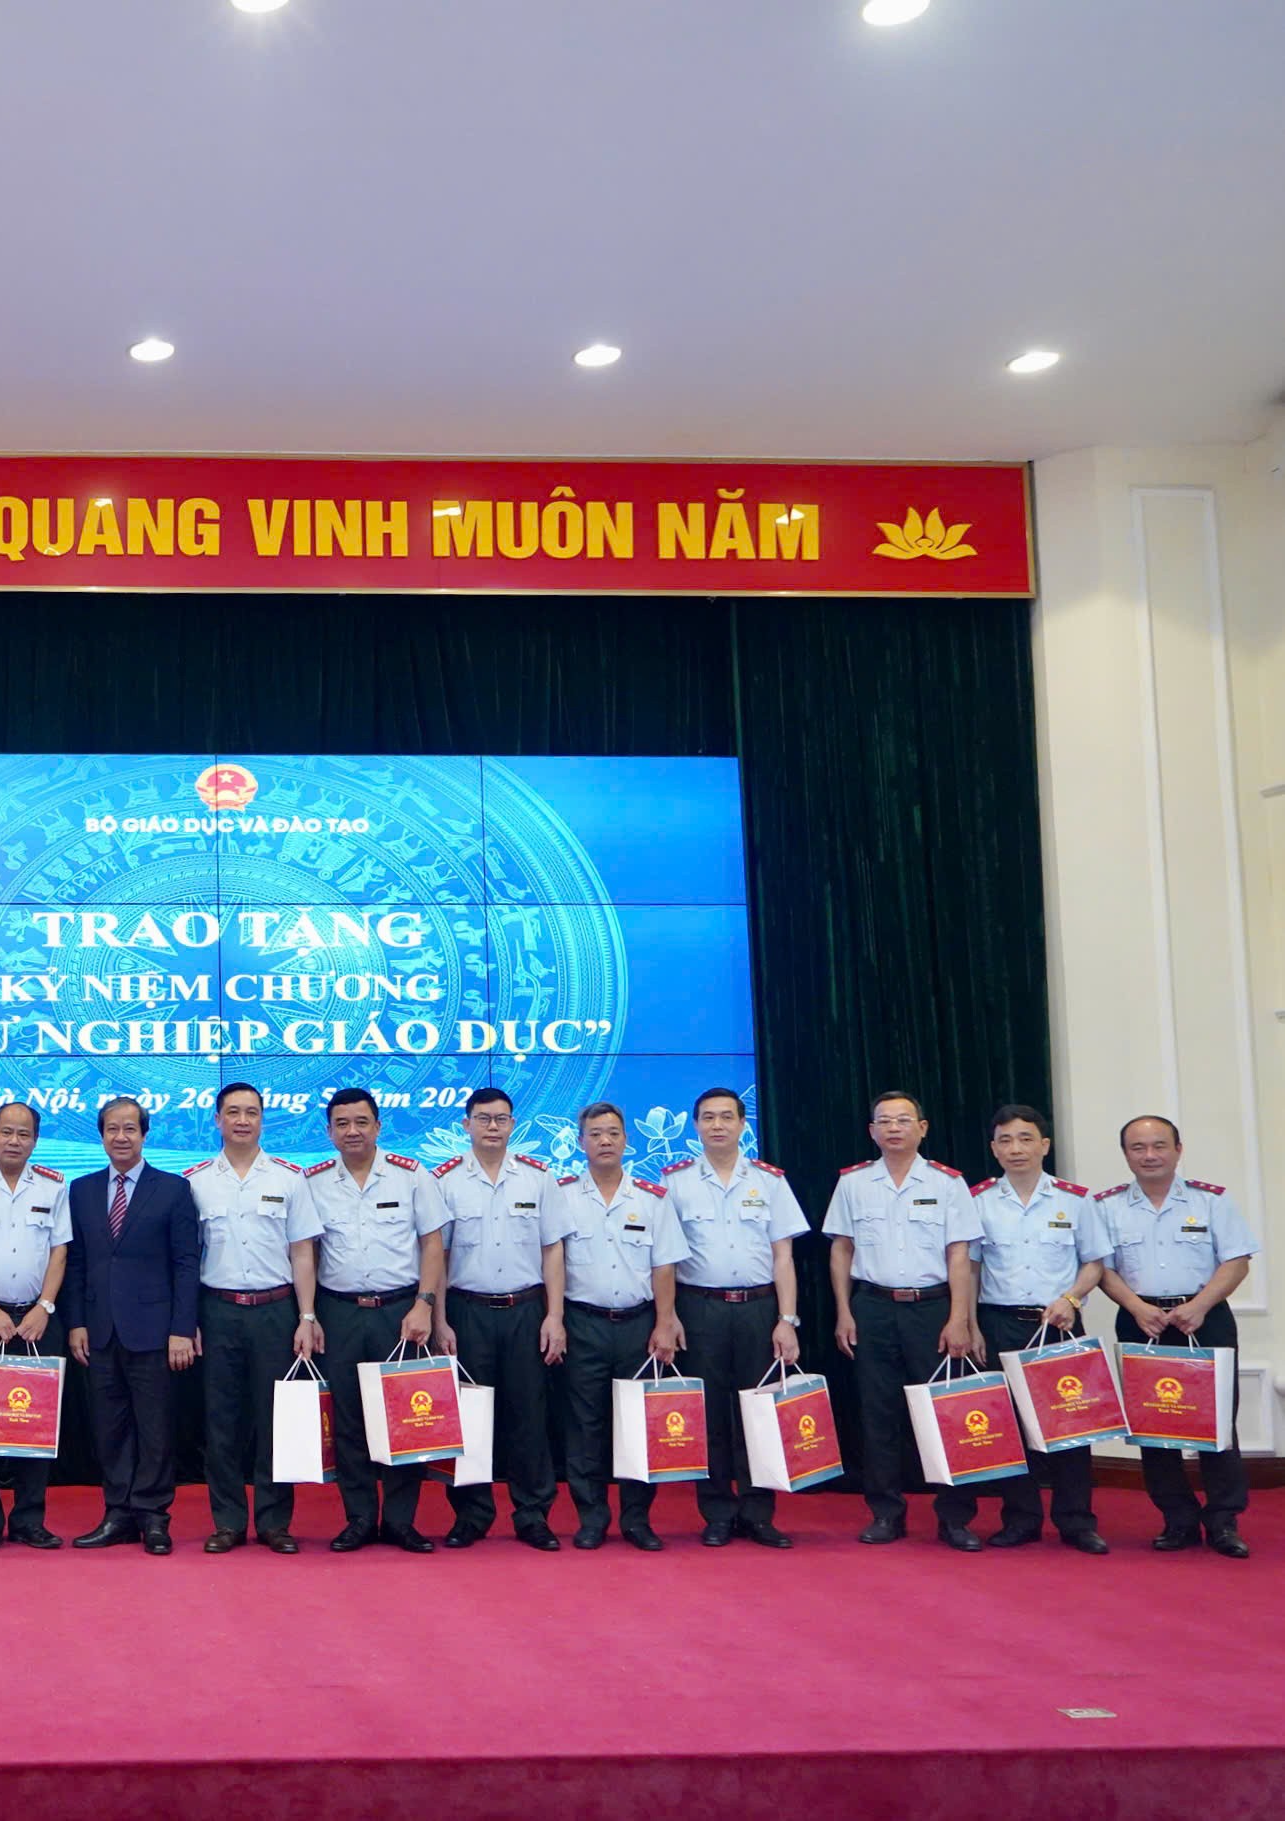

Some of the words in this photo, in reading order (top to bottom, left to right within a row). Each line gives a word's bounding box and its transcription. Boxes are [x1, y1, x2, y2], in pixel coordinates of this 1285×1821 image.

[248, 499, 409, 557] VINH
[433, 486, 634, 559] MUÔN
[659, 488, 820, 561] NĂM
[85, 814, 118, 836] BỘ
[121, 814, 180, 833] GIÁO
[183, 817, 235, 836] DỤC
[238, 815, 270, 834] VÀ
[271, 815, 323, 833] ĐÀO
[325, 817, 370, 836] TẠO
[32, 911, 219, 949] TRAO
[238, 907, 424, 957] TẶNG
[82, 971, 213, 1009] NIỆM
[224, 968, 442, 1002] CHƯƠNG
[33, 1015, 270, 1063] NGHIỆP
[282, 1011, 441, 1054] GIÁO
[25, 1087, 86, 1114] Nội,
[178, 1087, 217, 1109] 26
[418, 1086, 488, 1108] 202
